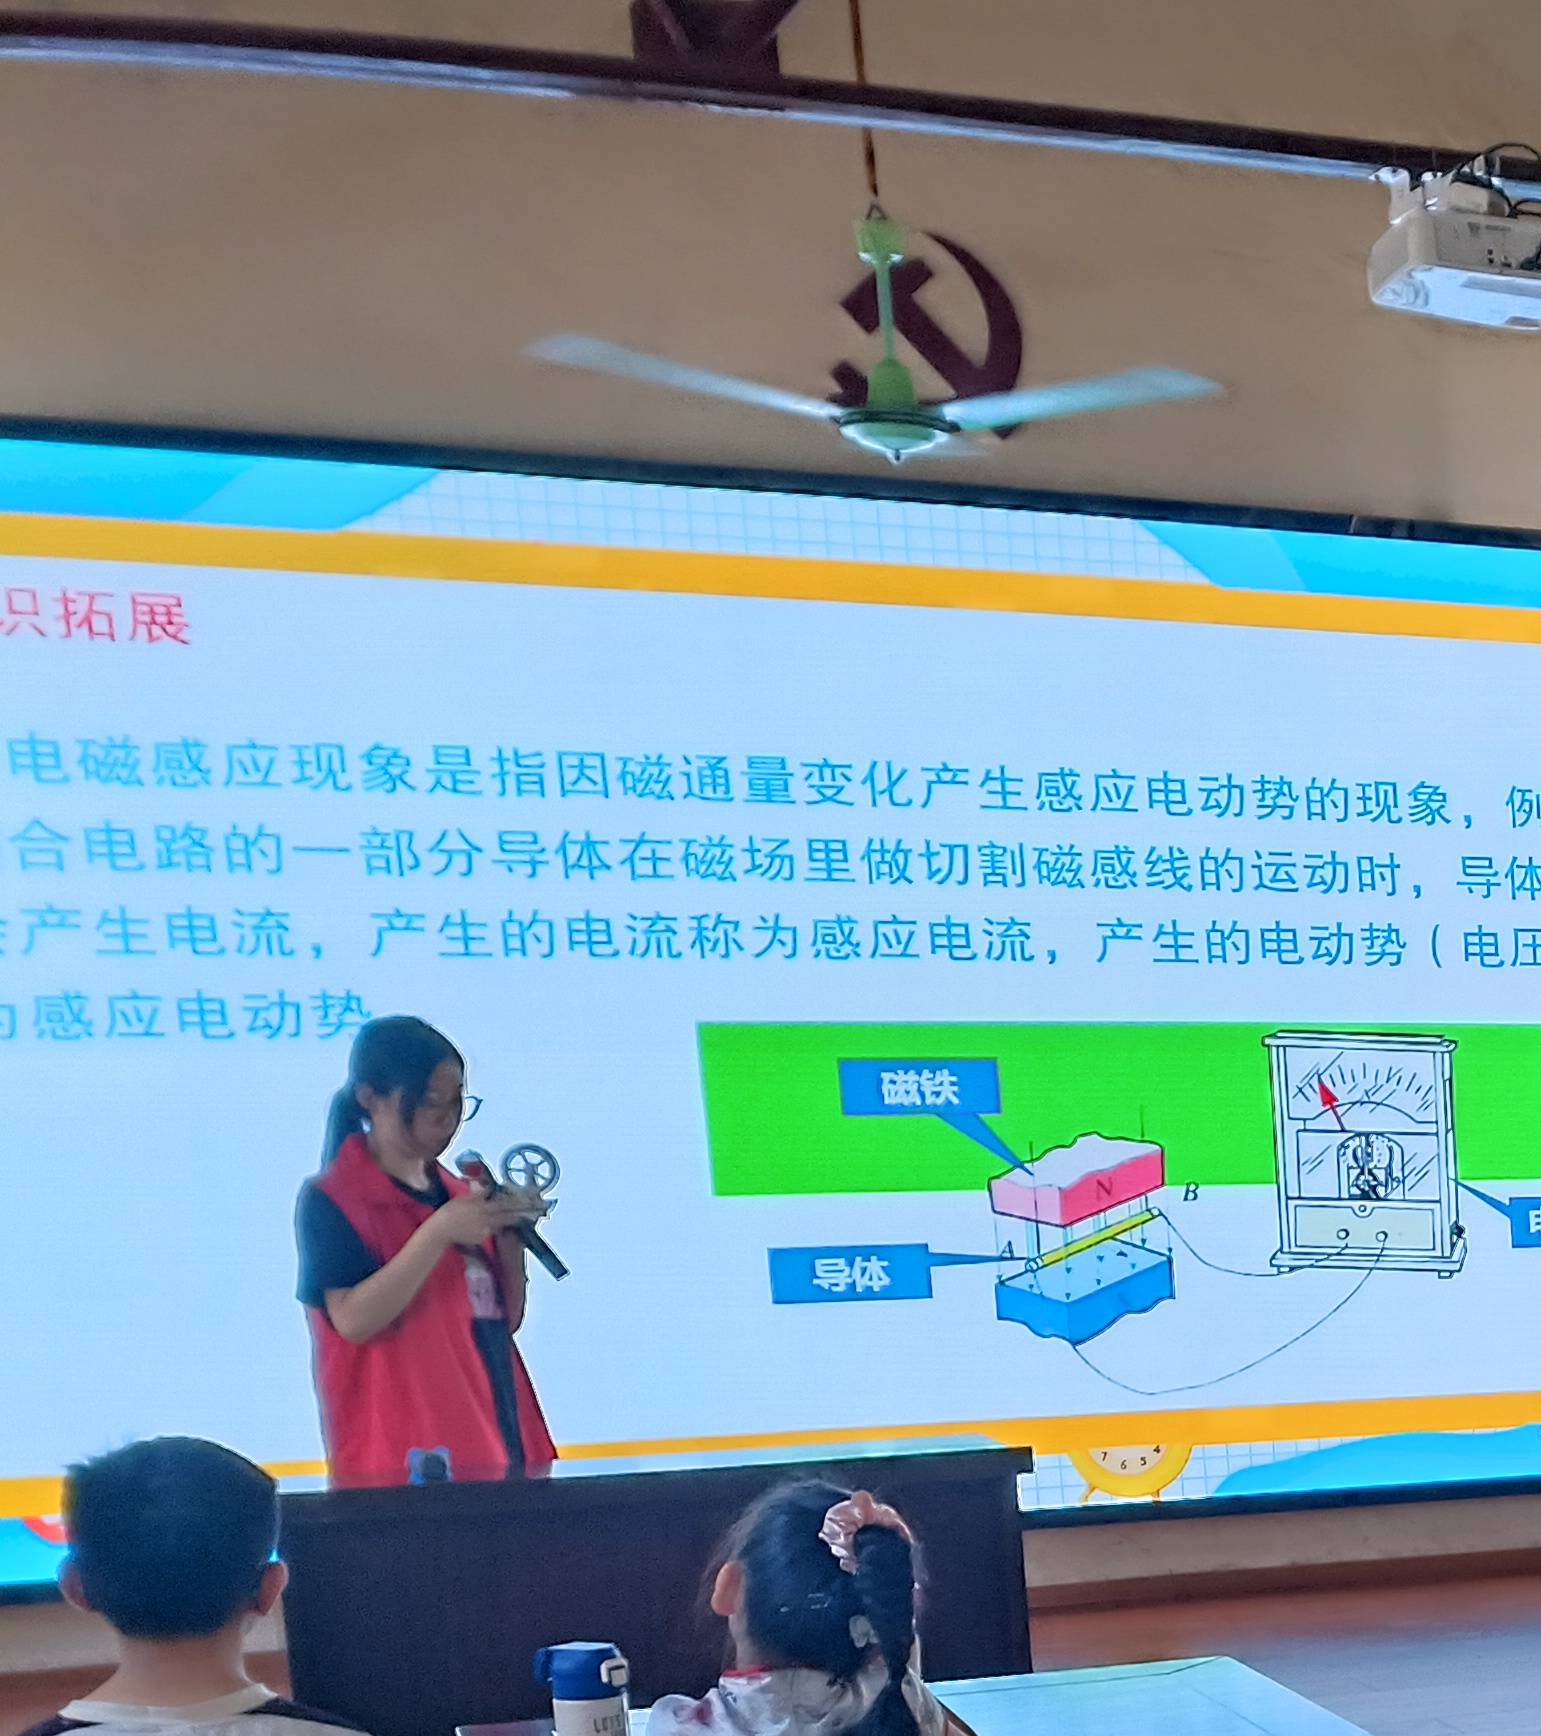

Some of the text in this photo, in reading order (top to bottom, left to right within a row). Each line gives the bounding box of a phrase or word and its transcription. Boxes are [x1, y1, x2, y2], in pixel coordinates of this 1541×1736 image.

[880, 1068, 961, 1106] 磁铁
[1095, 1176, 1114, 1201] N
[1183, 1181, 1200, 1202] B
[812, 1255, 892, 1293] 导体
